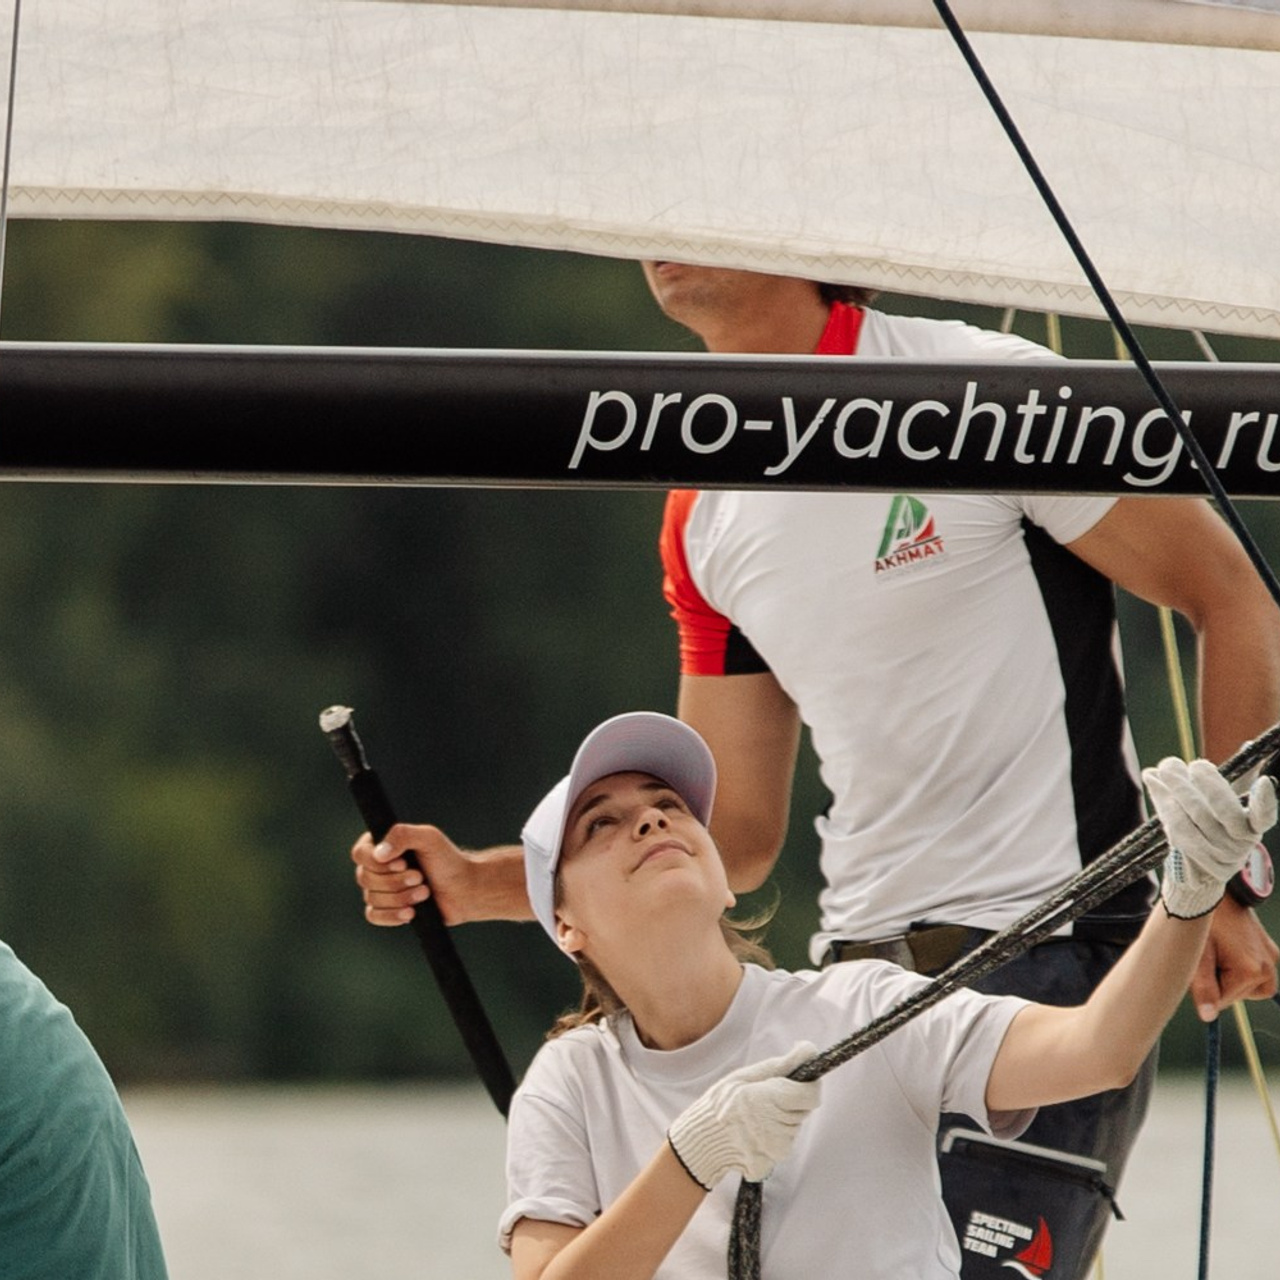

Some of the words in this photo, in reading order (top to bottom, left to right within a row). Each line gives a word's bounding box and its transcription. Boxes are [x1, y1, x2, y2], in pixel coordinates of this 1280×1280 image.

[873, 539, 944, 574] AKHMAT
[963, 1236, 998, 1258] TEAM
[966, 1223, 1015, 1249] SAILING
